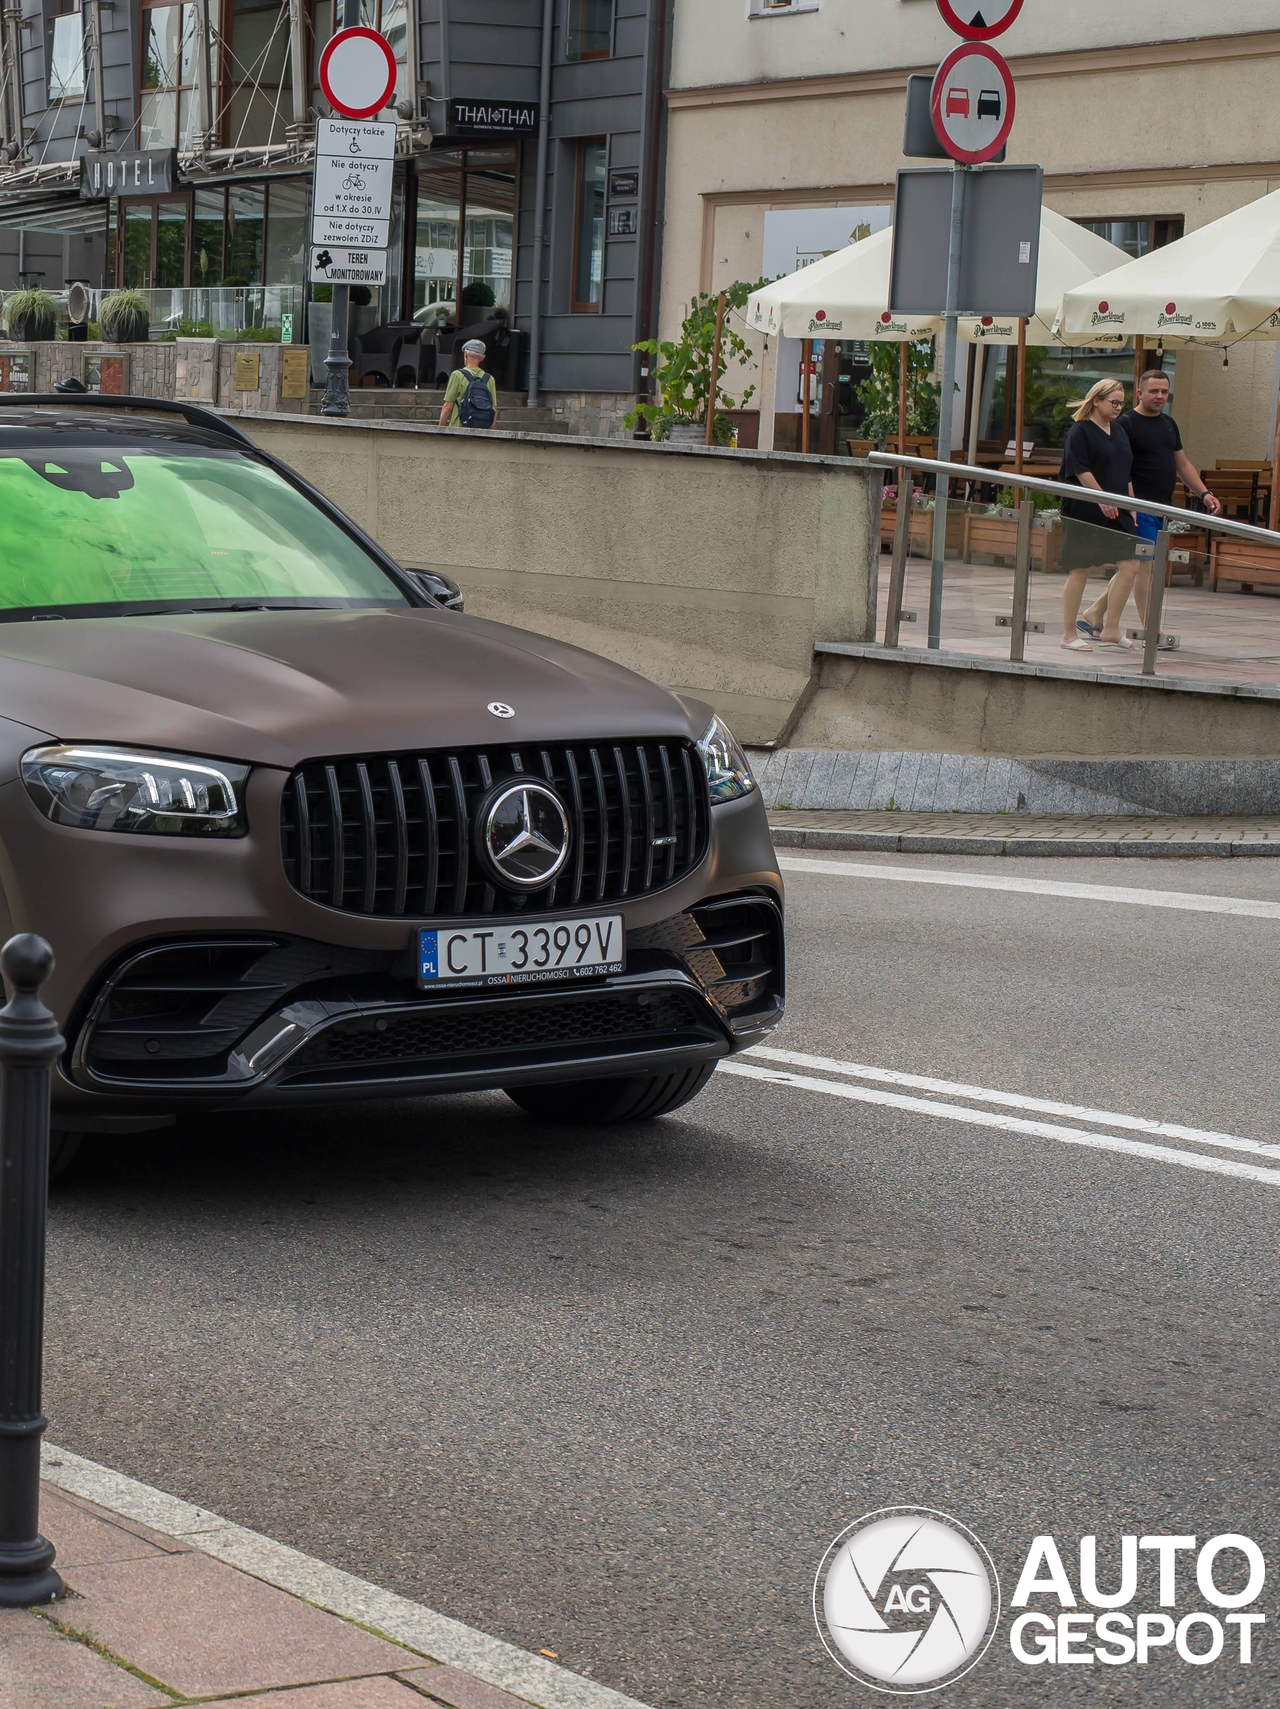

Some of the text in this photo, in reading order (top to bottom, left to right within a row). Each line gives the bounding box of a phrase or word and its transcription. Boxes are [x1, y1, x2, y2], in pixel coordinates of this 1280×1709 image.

[455, 105, 535, 126] THAI THAI
[329, 124, 386, 137] Dotyczy także
[331, 160, 379, 172] Nie dotyczy
[94, 158, 155, 189] HOTEL
[343, 193, 372, 203] okresie
[323, 204, 382, 215] od 1.X do 30.IV
[329, 221, 375, 233] Nie dotyczy
[323, 233, 379, 244] zezwoleń ZDiZ
[348, 252, 369, 265] TEREN
[330, 268, 383, 282] MONITOROWANY
[447, 920, 613, 974] CT 3399V
[422, 962, 436, 974] PL
[579, 963, 622, 976] 602 762 462
[487, 969, 570, 985] OSSA NIERUCHOMOŚCI
[423, 980, 483, 989] www.ossa-nieruchomosci.pl
